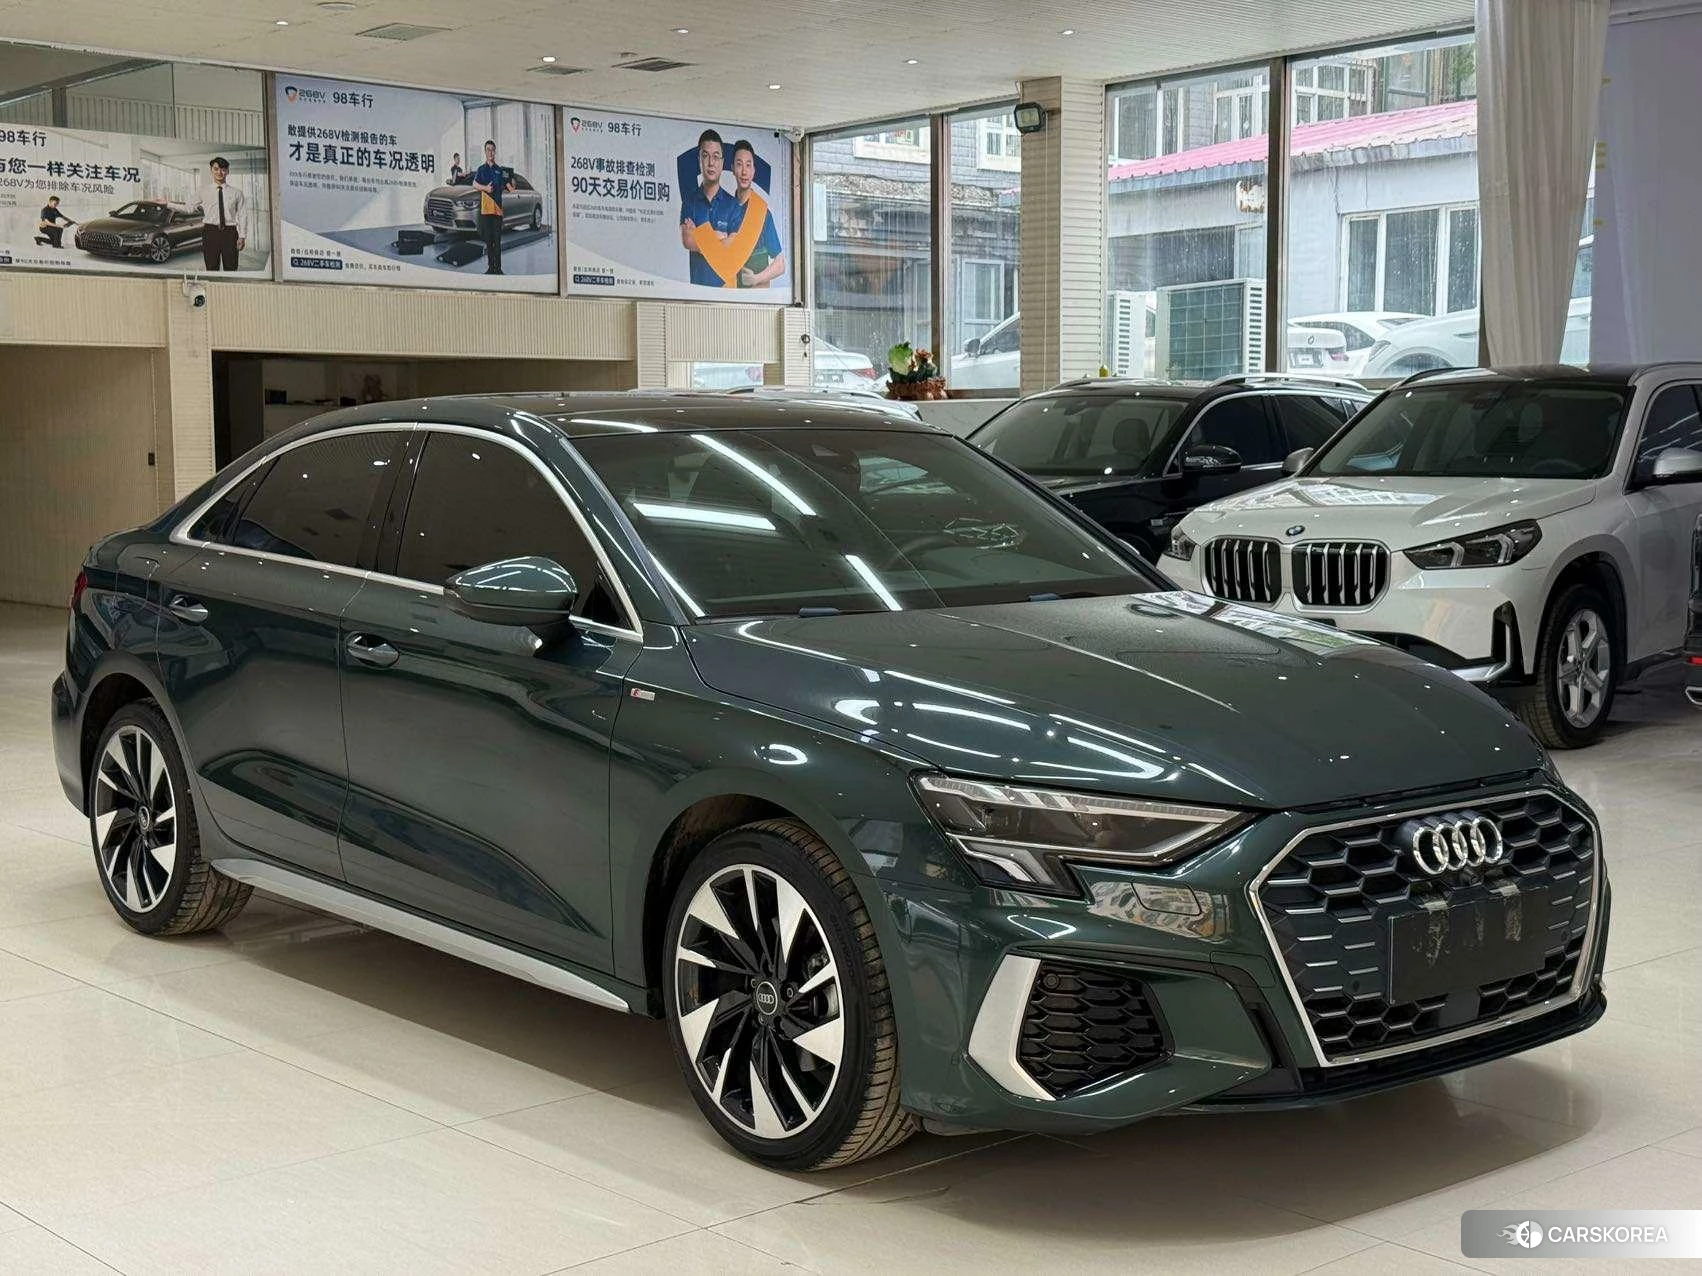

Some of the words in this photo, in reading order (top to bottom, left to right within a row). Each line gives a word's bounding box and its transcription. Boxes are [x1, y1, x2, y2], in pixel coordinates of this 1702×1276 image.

[333, 92, 374, 108] 98车行
[287, 124, 398, 146] 敢提供268V检测报告的车
[608, 122, 642, 136] 98车行
[289, 141, 435, 174] 才是真正的车况透明
[571, 156, 656, 177] 268V事故排查检测
[572, 176, 670, 202] 90天交易价回购
